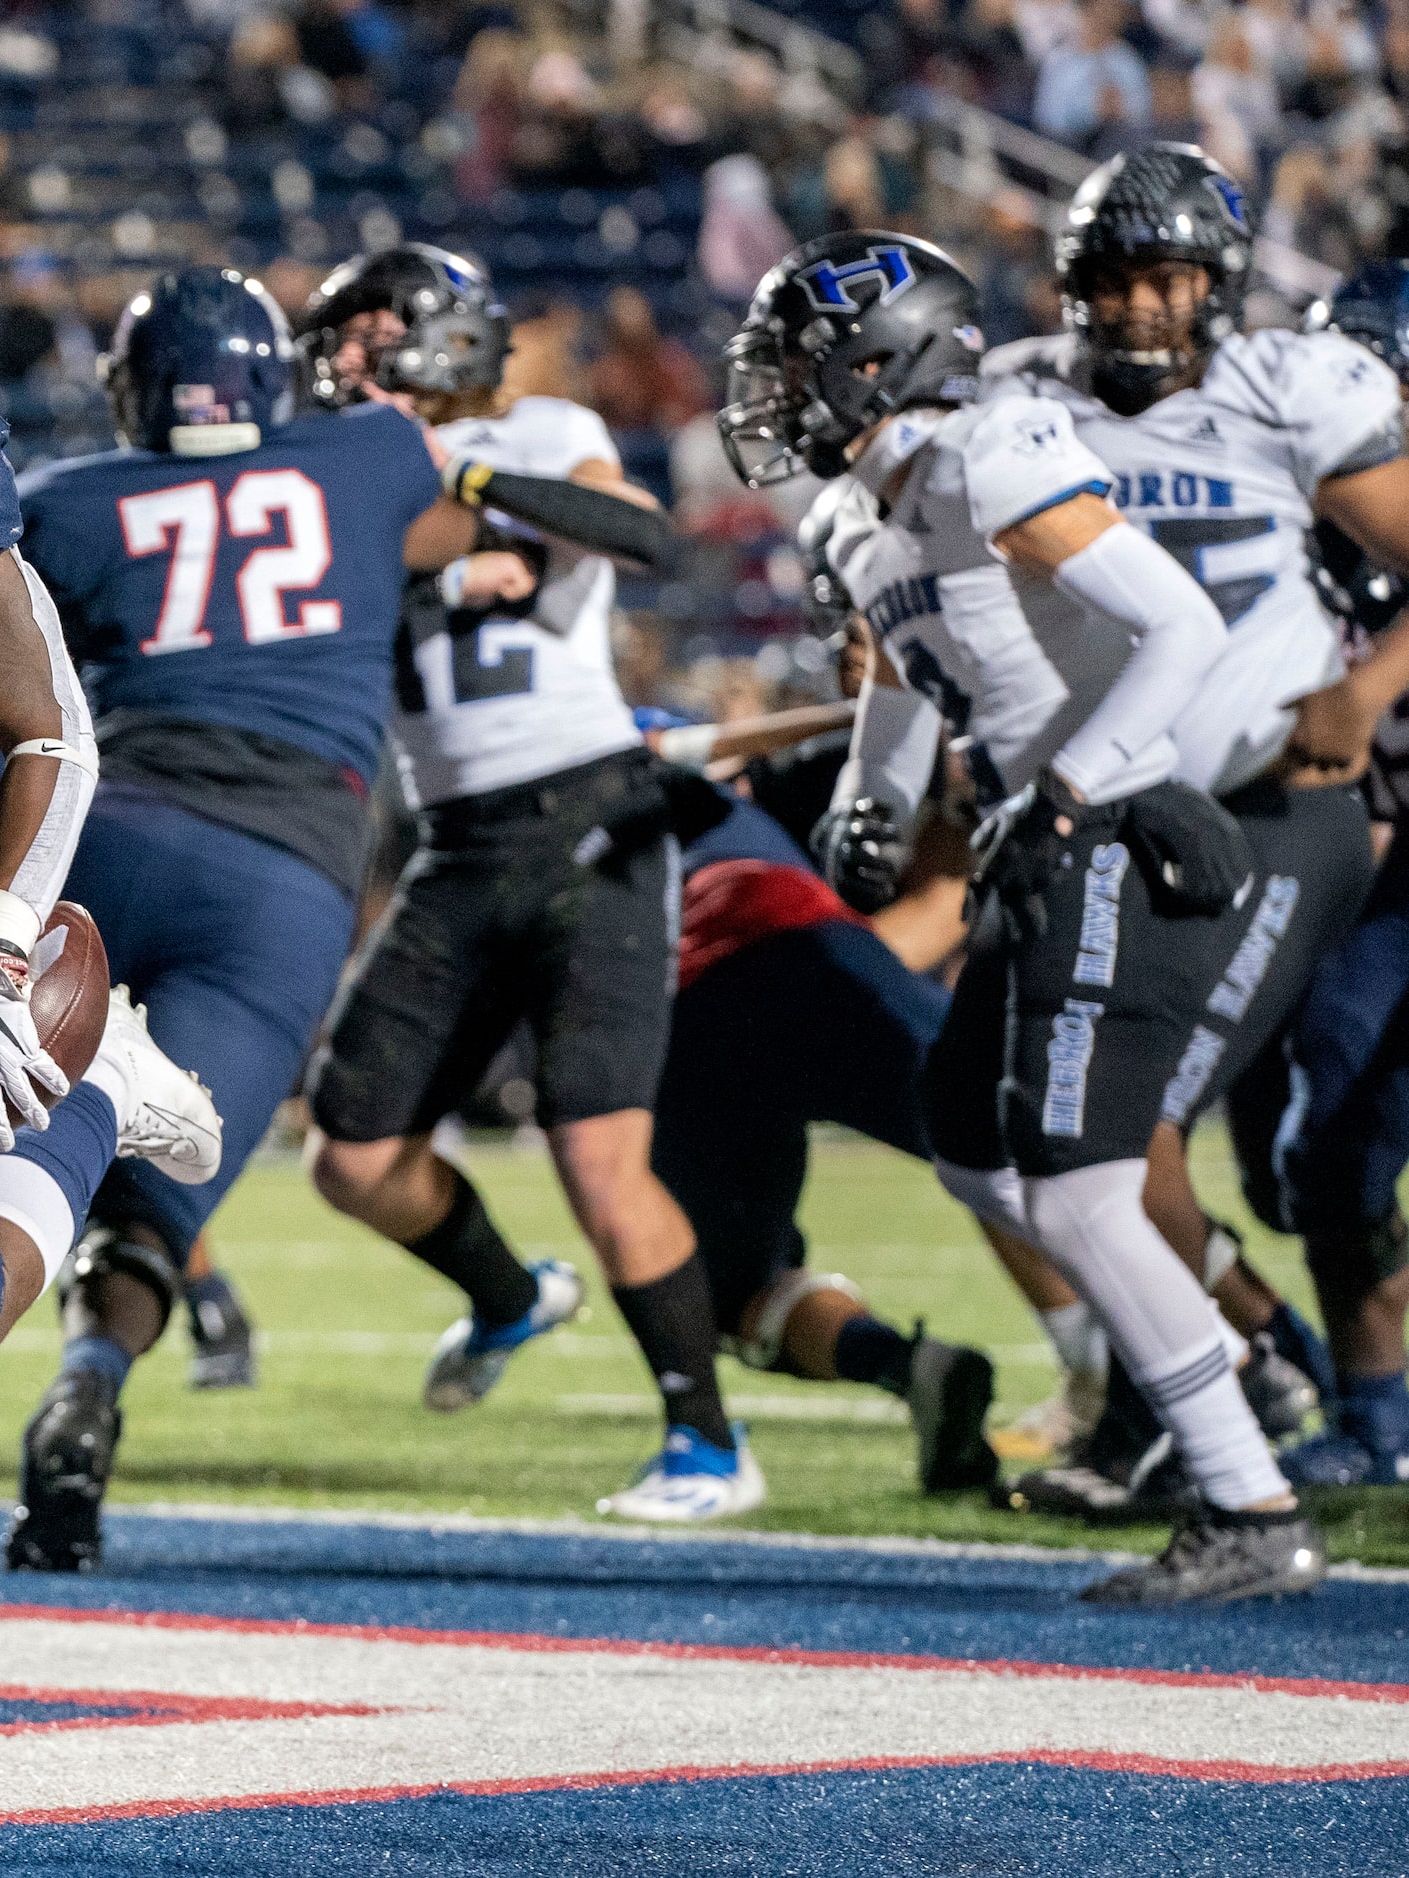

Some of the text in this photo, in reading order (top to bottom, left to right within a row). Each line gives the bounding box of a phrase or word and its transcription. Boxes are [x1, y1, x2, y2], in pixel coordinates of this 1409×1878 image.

[795, 245, 916, 314] H
[117, 468, 342, 656] 72
[1072, 842, 1130, 988] HAWKS
